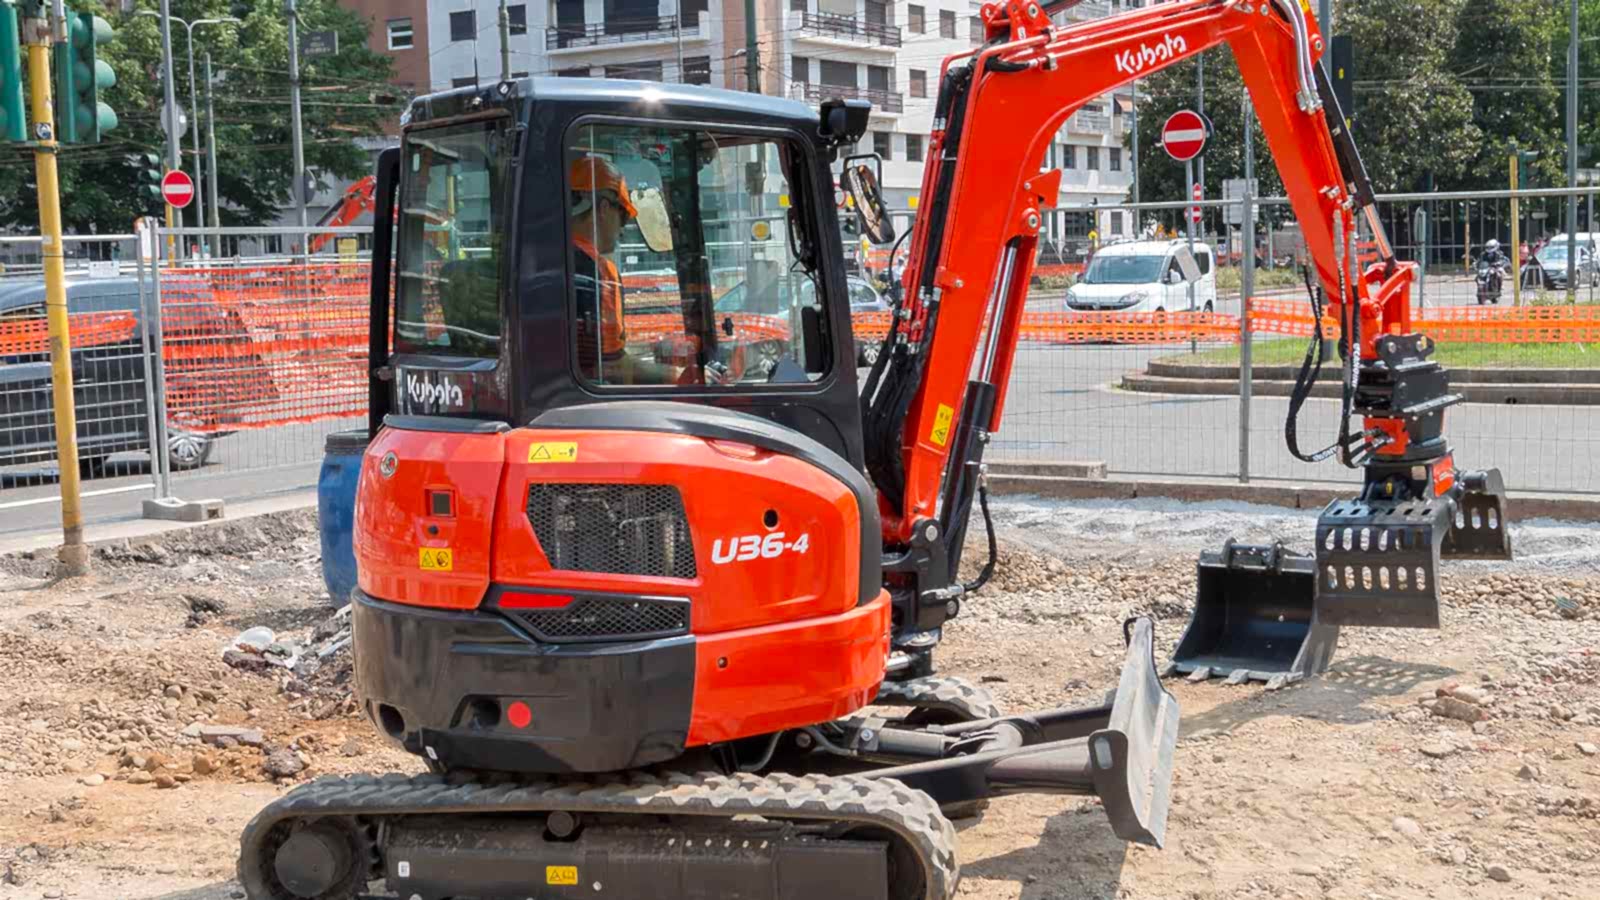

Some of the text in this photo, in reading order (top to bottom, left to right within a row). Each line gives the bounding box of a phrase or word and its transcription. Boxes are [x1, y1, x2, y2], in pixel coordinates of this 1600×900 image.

[1115, 33, 1187, 74] Kubota
[407, 374, 463, 406] Kubota
[711, 532, 809, 564] U36-4
